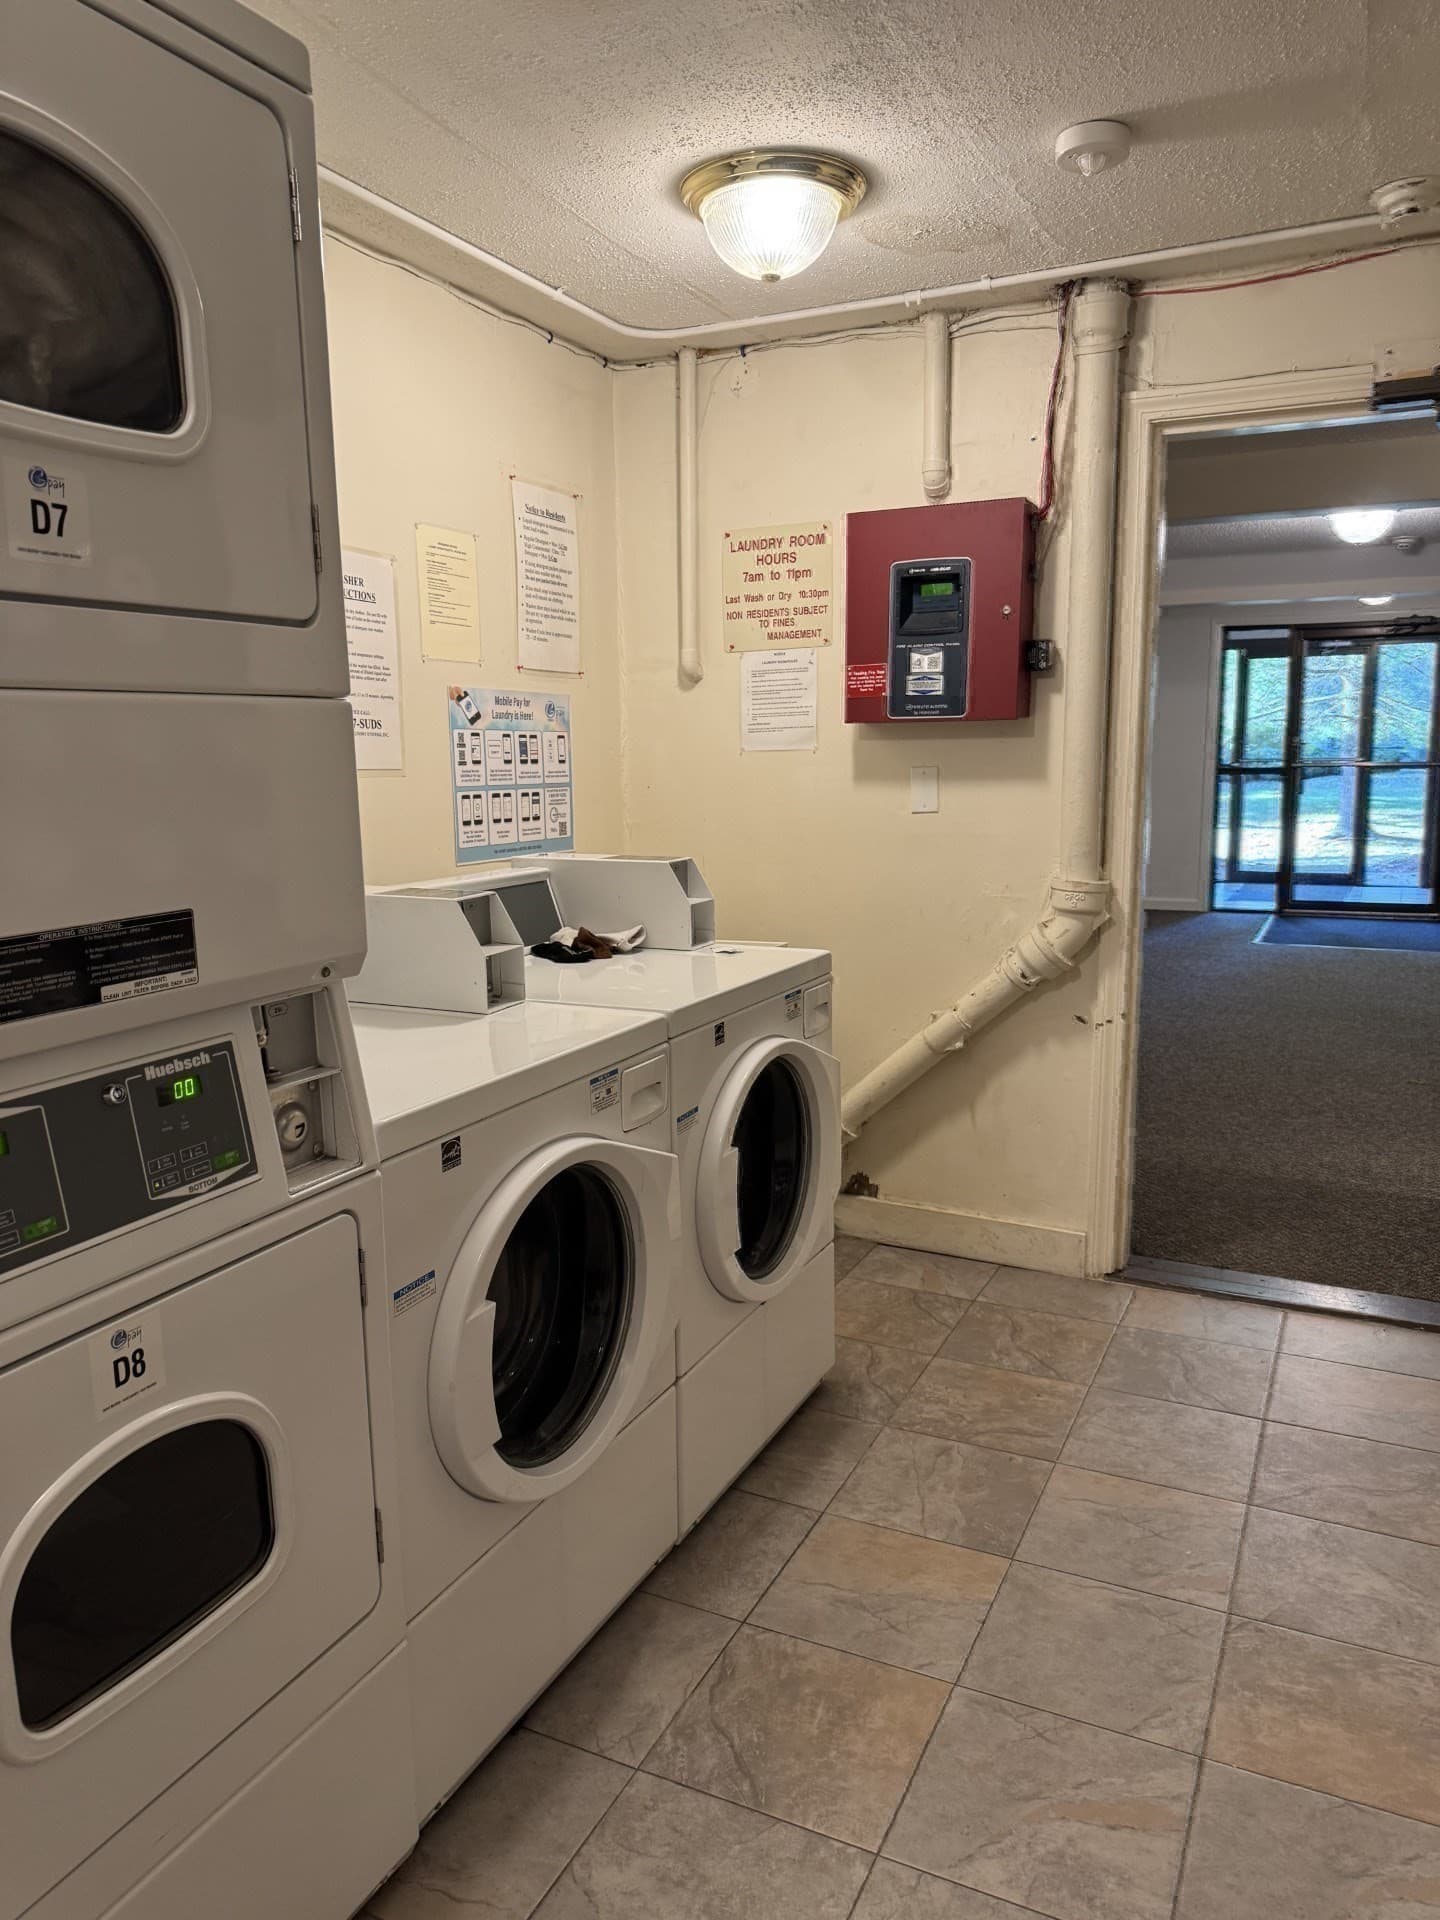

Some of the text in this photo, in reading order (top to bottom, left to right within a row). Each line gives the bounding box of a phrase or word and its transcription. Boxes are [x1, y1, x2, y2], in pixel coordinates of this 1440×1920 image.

[30, 498, 67, 537] D7
[730, 533, 826, 553] LAUNDRY ROOM
[756, 551, 797, 566] HOURS
[344, 574, 364, 587] SHER
[743, 568, 812, 583] 7am to 11pm
[725, 589, 829, 605] Last Wash or Dry 10:30pm
[726, 604, 829, 620] NON RESIDENTS SUBJECT
[759, 617, 795, 628] TO FINES
[767, 628, 822, 641] MANAGEMENT
[494, 696, 531, 709] Mobile Pay for
[491, 709, 534, 722] Laundry is Here!
[134, 976, 167, 988] IMPORTANT:
[103, 993, 120, 1001] CLEAN
[133, 986, 149, 994] FILTER
[150, 983, 169, 991] BEFORE
[143, 1051, 212, 1081] Huebsch
[173, 1078, 195, 1099] 00
[188, 1176, 218, 1193] BOTTOM
[400, 1273, 431, 1297] NOTICE
[113, 1347, 146, 1388] D8
